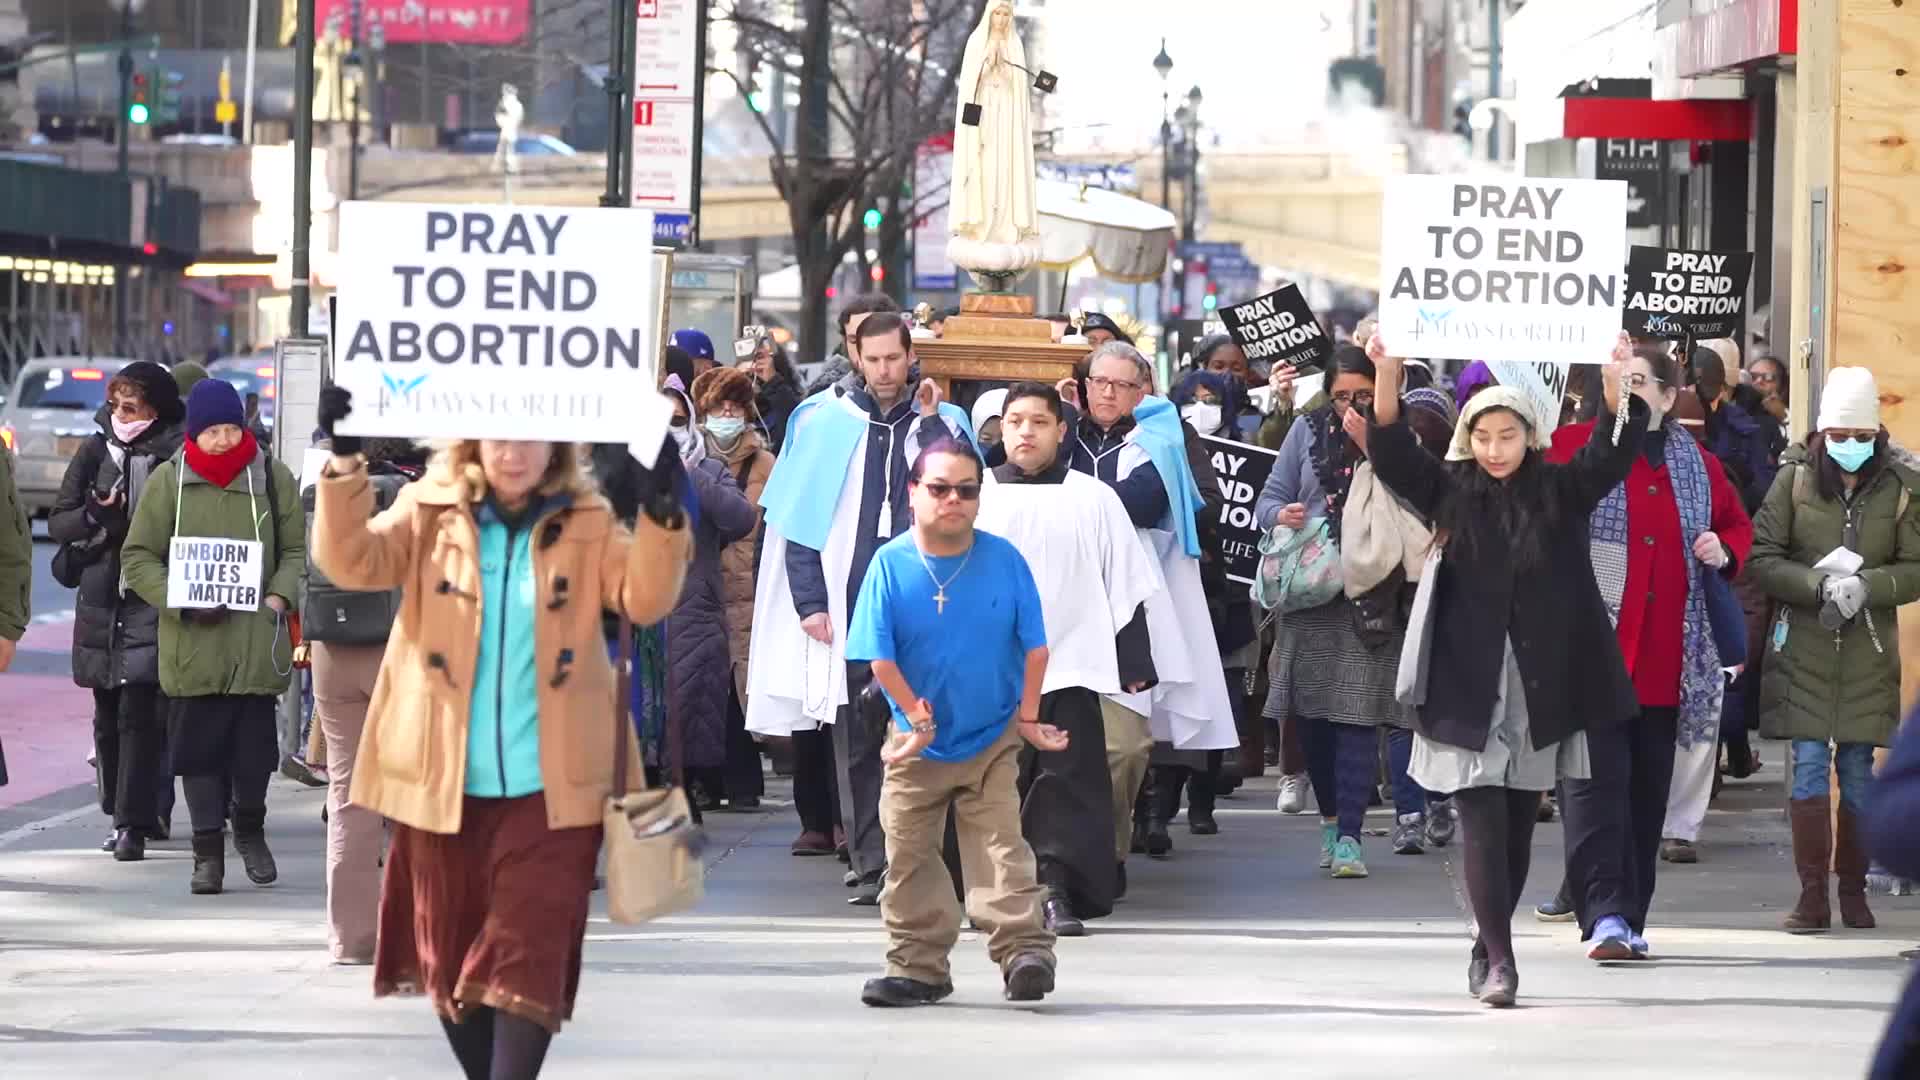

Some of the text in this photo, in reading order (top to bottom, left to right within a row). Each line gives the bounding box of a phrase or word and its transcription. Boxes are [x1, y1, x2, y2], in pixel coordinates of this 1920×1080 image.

[640, 103, 649, 125] 1
[1452, 184, 1564, 220] PRAY
[426, 211, 569, 256] PRAY
[1427, 225, 1584, 263] TO END
[1666, 252, 1727, 274] PRAY
[392, 265, 597, 312] TO END
[1389, 266, 1616, 307] ABORTION
[1651, 271, 1685, 293] TO
[1689, 274, 1733, 294] END
[1234, 296, 1276, 323] PRAY
[1627, 291, 1742, 315] ABORTION
[1237, 311, 1296, 342] TO END
[1241, 321, 1321, 359] ABORTION
[345, 320, 640, 369] ABORTION
[1209, 451, 1248, 478] AY
[1216, 476, 1255, 505] ND
[175, 543, 248, 563] UNBORN
[184, 563, 240, 583] LIVES
[188, 583, 256, 605] MATTER
